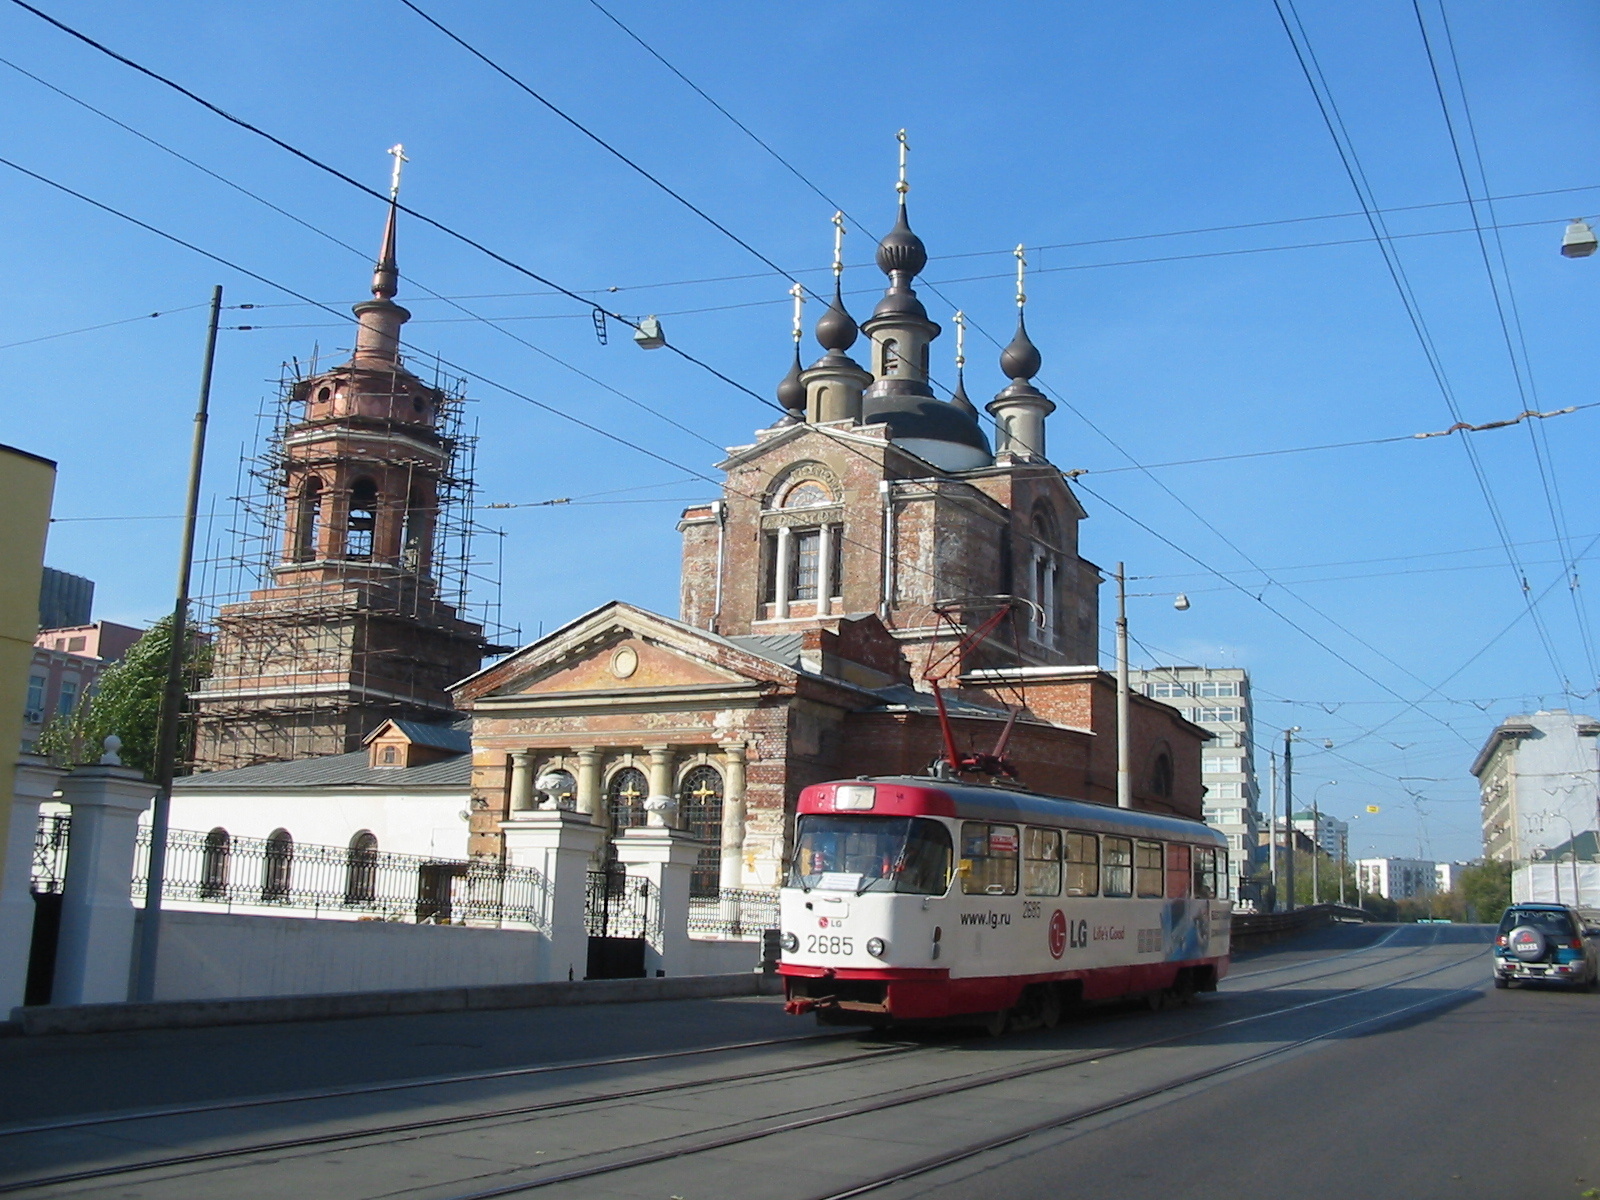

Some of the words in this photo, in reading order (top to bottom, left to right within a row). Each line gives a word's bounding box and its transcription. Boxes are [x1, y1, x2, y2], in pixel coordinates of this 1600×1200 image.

[960, 909, 1011, 929] www.lg.ru
[1022, 901, 1041, 918] 2685
[830, 919, 842, 928] LG
[1070, 919, 1087, 948] LG
[1109, 925, 1125, 940] Good
[807, 934, 854, 955] 2685
